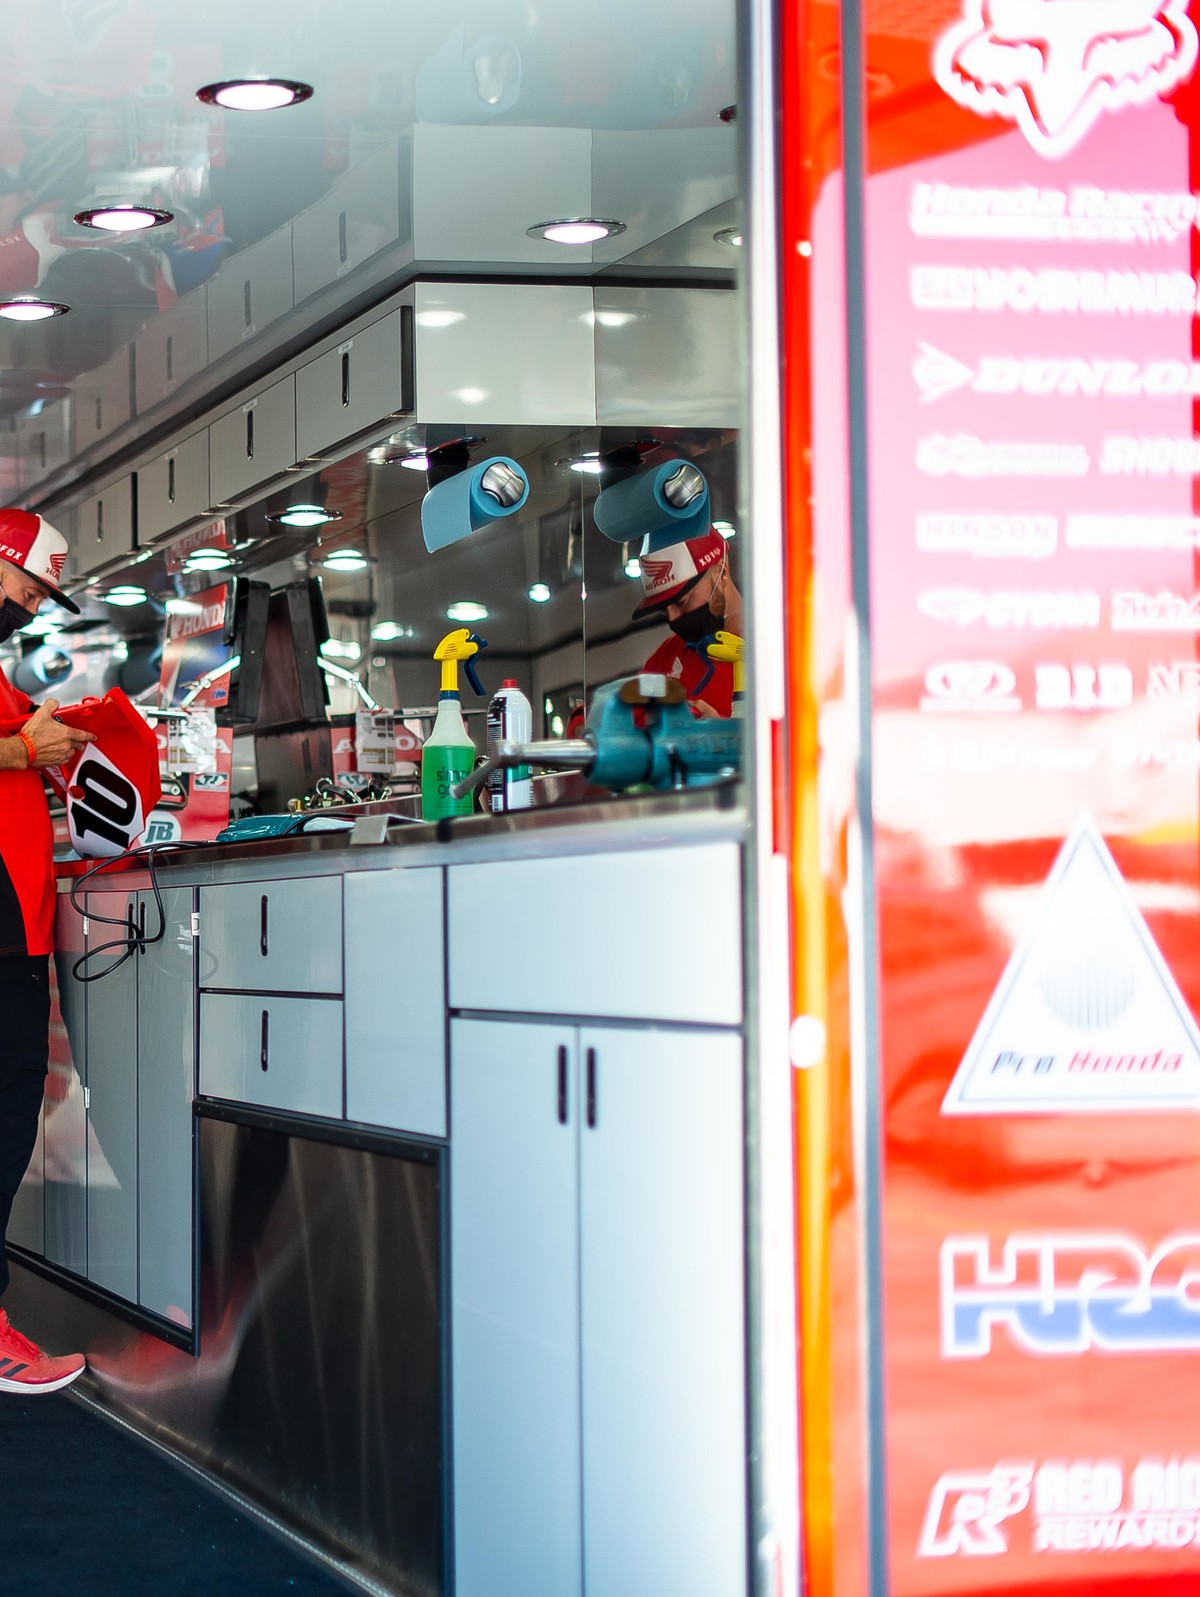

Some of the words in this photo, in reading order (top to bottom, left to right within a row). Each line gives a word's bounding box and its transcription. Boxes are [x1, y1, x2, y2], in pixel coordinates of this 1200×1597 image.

[913, 183, 1067, 218] Honda
[977, 268, 1200, 314] YOSHIMUR
[1100, 438, 1200, 474] SHOW
[0, 545, 23, 560] FOX
[71, 759, 137, 850] 10
[1067, 1049, 1184, 1073] Honda
[1036, 1461, 1122, 1513] RED
[1133, 1458, 1200, 1510] RID
[1035, 1517, 1200, 1550] REWARD
